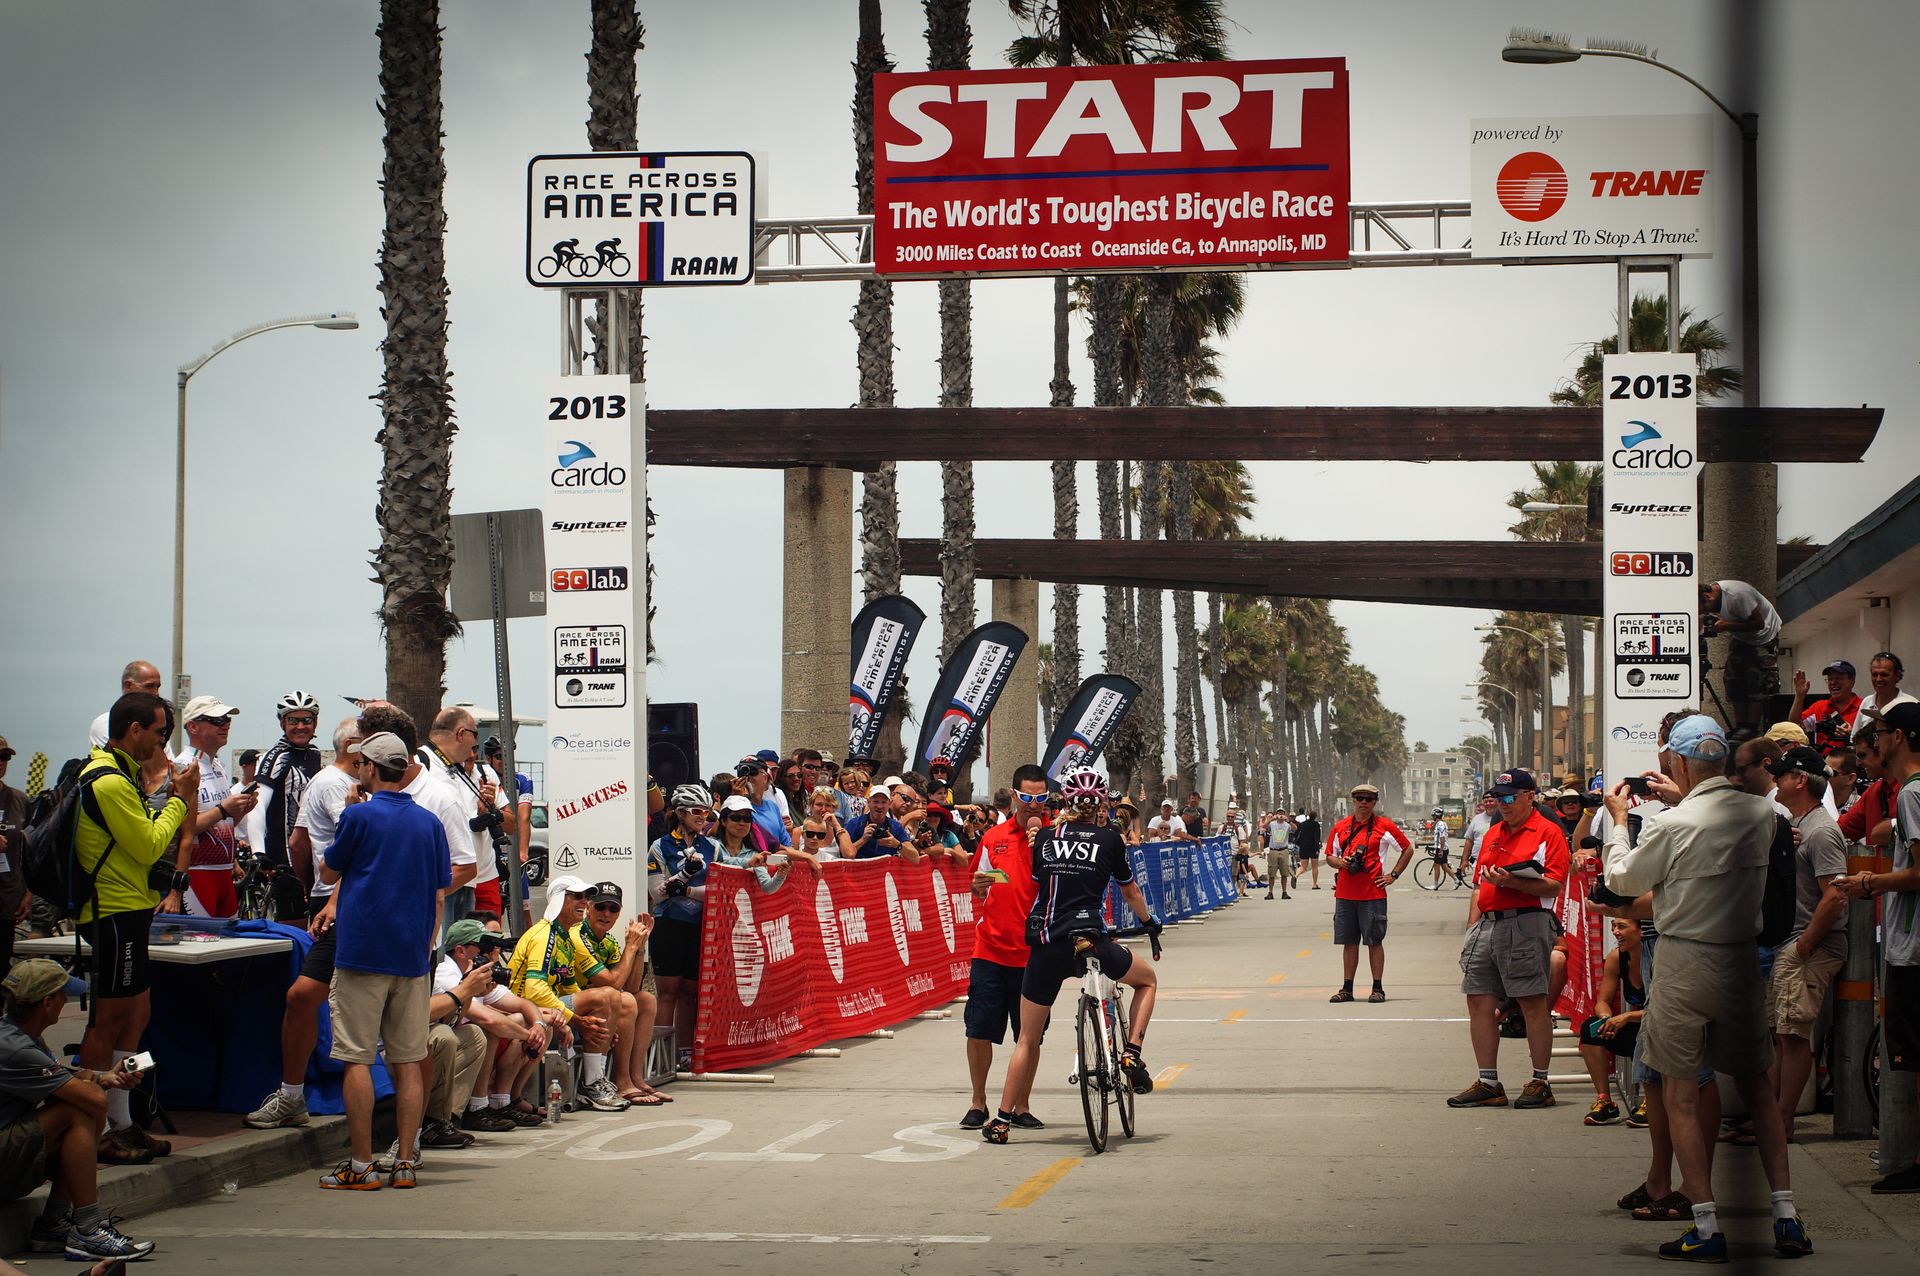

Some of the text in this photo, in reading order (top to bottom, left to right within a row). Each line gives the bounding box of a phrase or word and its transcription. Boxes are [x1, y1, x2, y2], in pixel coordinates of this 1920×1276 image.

[885, 71, 1334, 162] START
[1472, 126, 1563, 144] powered by
[545, 172, 737, 189] RACE ACROSS
[1590, 170, 1705, 197] TRANE
[545, 192, 737, 218] AMERICA
[889, 190, 1333, 231] The World's Toughest Bicycle Race
[896, 234, 1326, 262] 3000 Miles Coast to Coast Oceanside Ca, to Annapolis, MD
[1500, 231, 1521, 246] It's
[1525, 230, 1567, 246] Hard
[1573, 230, 1590, 245] To
[1595, 230, 1629, 247] Stop
[1632, 229, 1646, 244] A
[671, 257, 738, 275] RAAM
[1610, 374, 1692, 399] 2013
[549, 395, 626, 420] 2013
[1612, 444, 1692, 468] cardo
[551, 462, 626, 487] cardo
[1610, 503, 1692, 514] Syntace
[551, 521, 627, 532] Syntace
[560, 638, 620, 647] AMERICA
[1620, 626, 1684, 634] AMERICA
[862, 622, 888, 687] RACE ACROSS
[866, 623, 895, 690] AMERICA
[879, 630, 910, 705] CHALLENGE
[963, 644, 993, 702] RACE ACROSS
[968, 646, 1000, 703] AMERICA
[951, 652, 1015, 767] CYCLING CHALLENGE
[1086, 692, 1116, 736] AMERICA
[1094, 698, 1127, 747] CHALLENGE
[556, 780, 627, 821] ALL ACCESS
[584, 847, 632, 855] TRACTALIS
[1052, 840, 1100, 863] WSI
[952, 893, 973, 924] TRANE
[761, 914, 794, 963] TRANE
[839, 907, 868, 946] TRANE
[738, 1019, 758, 1045] Hard
